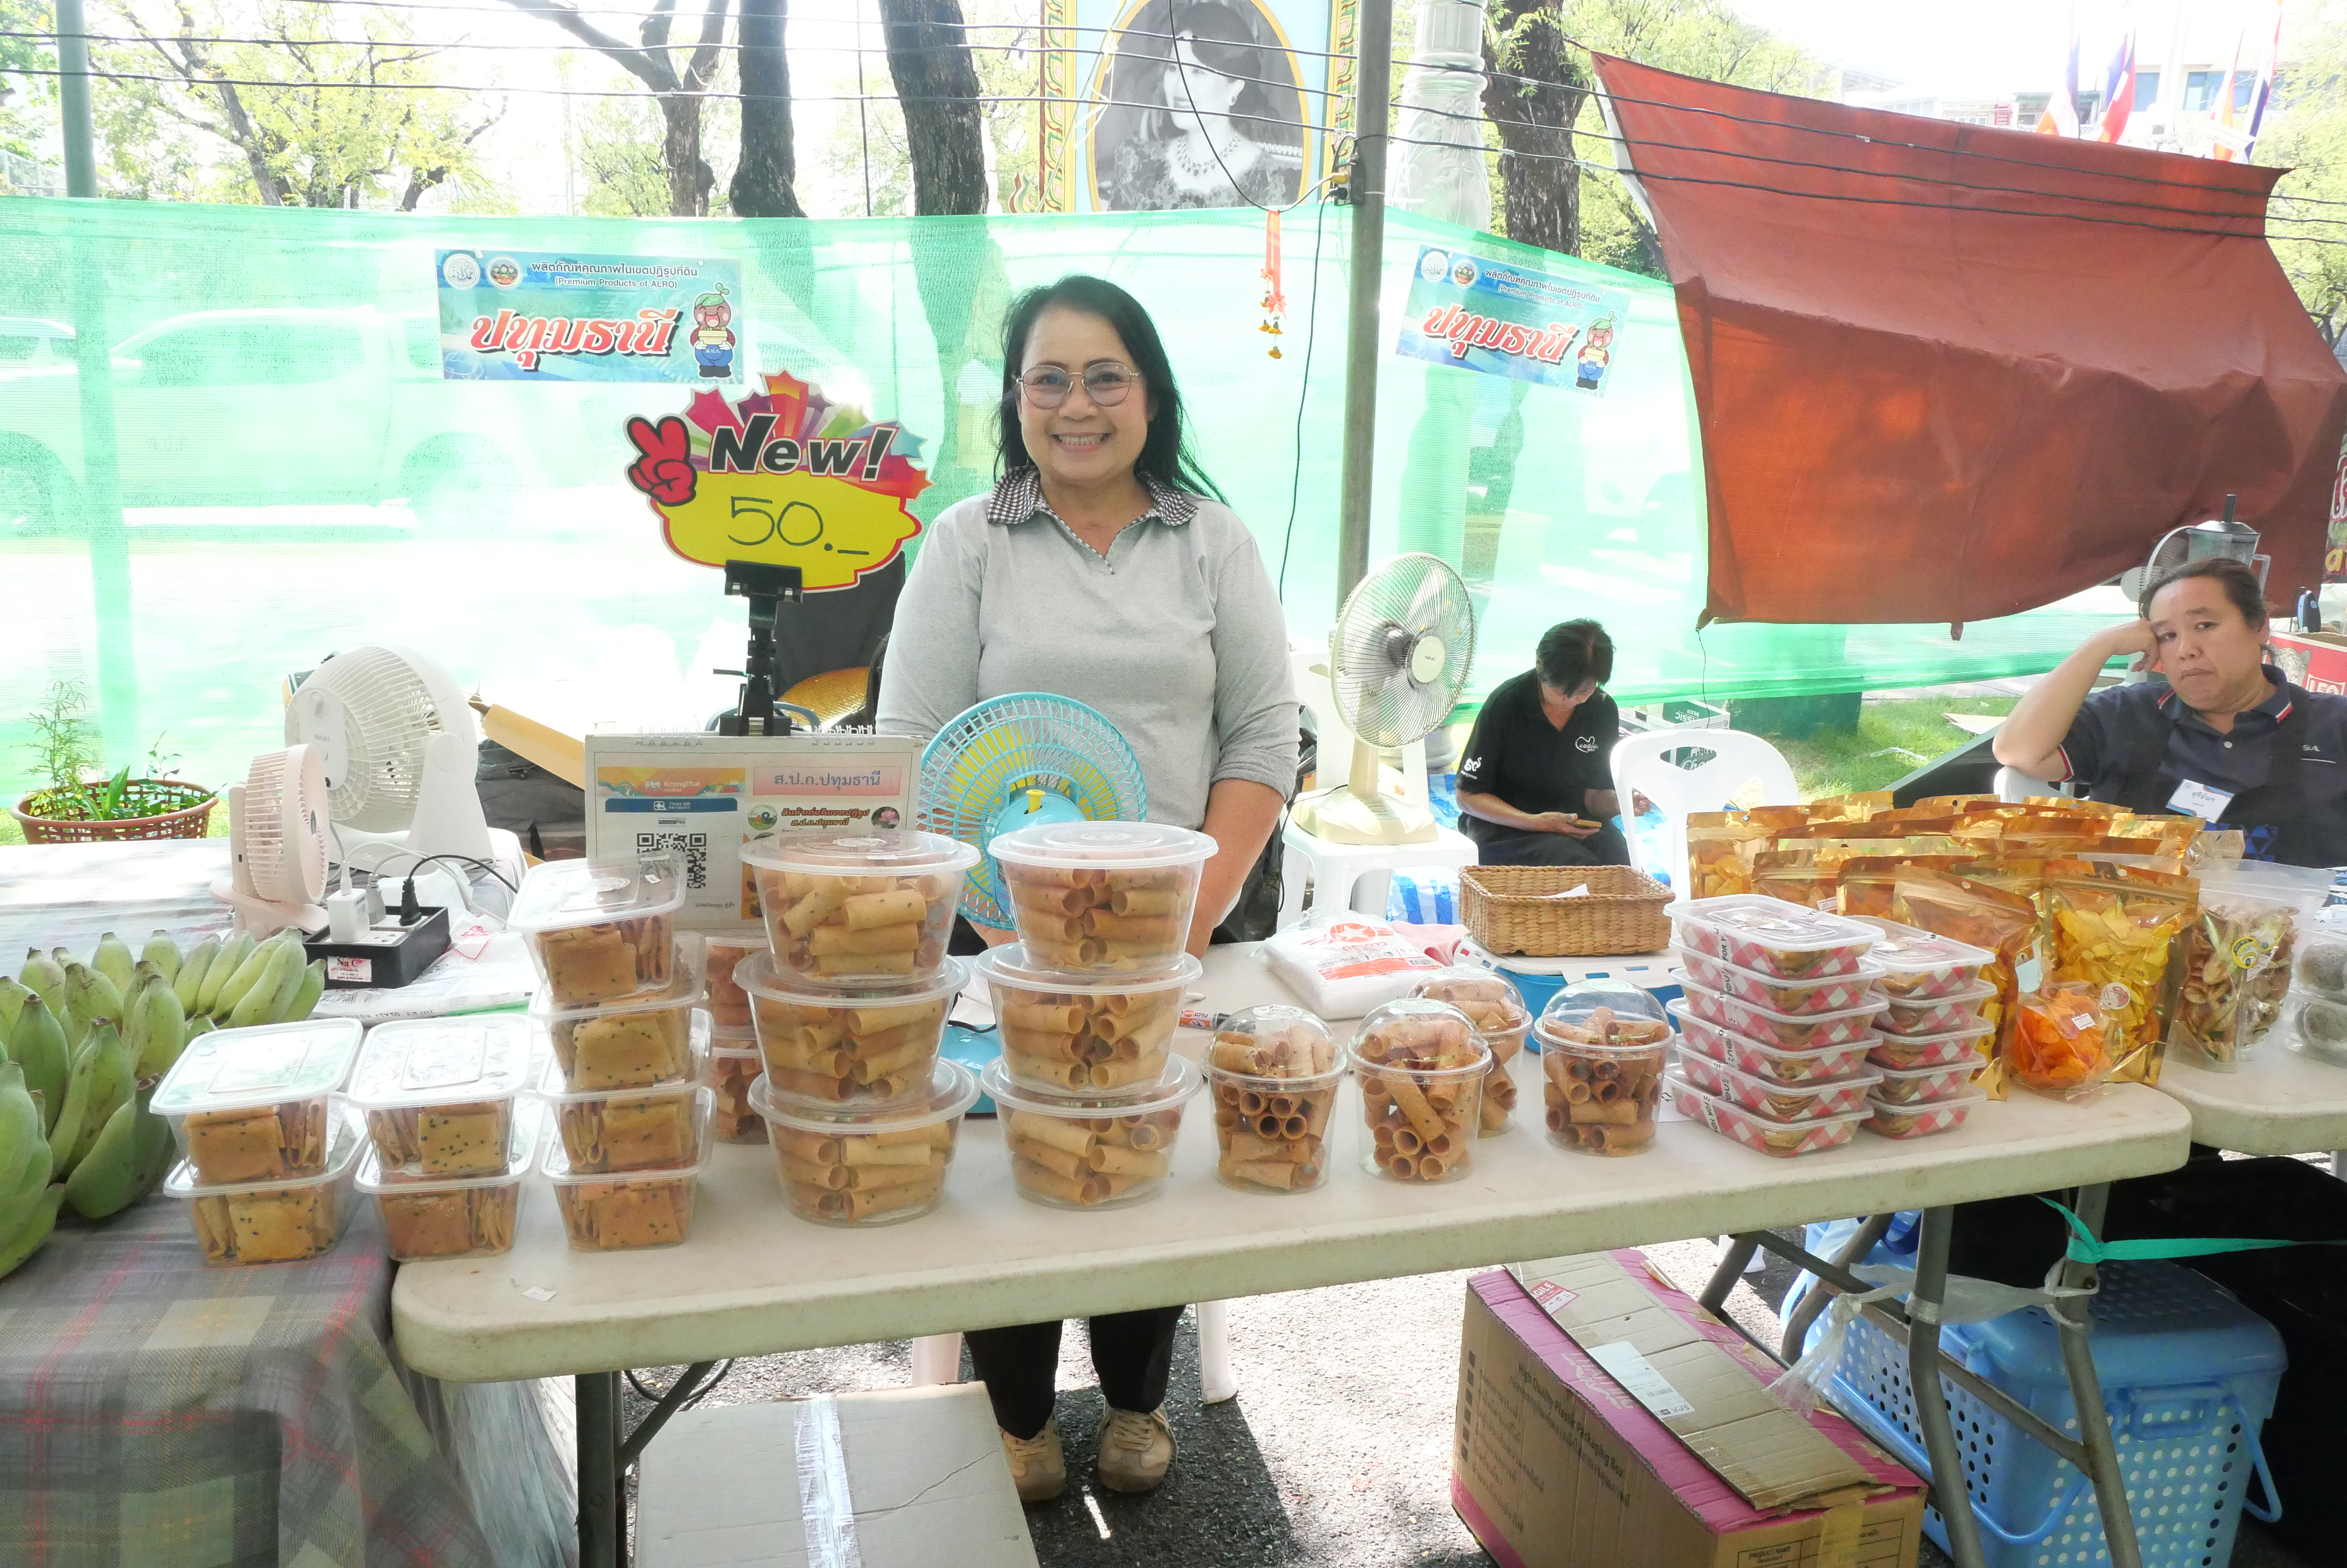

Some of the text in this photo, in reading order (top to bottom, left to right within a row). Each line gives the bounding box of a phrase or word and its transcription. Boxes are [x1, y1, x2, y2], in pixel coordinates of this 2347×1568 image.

[532, 262, 697, 278] ผลิตภัณฑ์คุณภาพในเขตปฏิรูปที่ดิน
[555, 277, 596, 286] (Premium
[599, 279, 636, 288] Products
[651, 281, 677, 289] ALRO)
[1485, 270, 1600, 303] ผลิตภัณฑ์คุณภาพในเขตปฏิรูปที่ดิน
[1498, 285, 1527, 297] (Premium
[1529, 292, 1555, 303] Products
[1565, 302, 1583, 310] ALRO)
[472, 309, 681, 371] ปทุมธานี
[1423, 303, 1578, 364] ปทุมธานี
[709, 413, 898, 481] New!
[1687, 709, 1700, 717] BEER
[664, 781, 700, 790] Krungthai
[774, 770, 881, 790] ส.ป.ก.ปทุมธานี
[1518, 1362, 1623, 1479] High Quality Plastic Packaging Box
[1671, 1405, 1689, 1414] SPX
